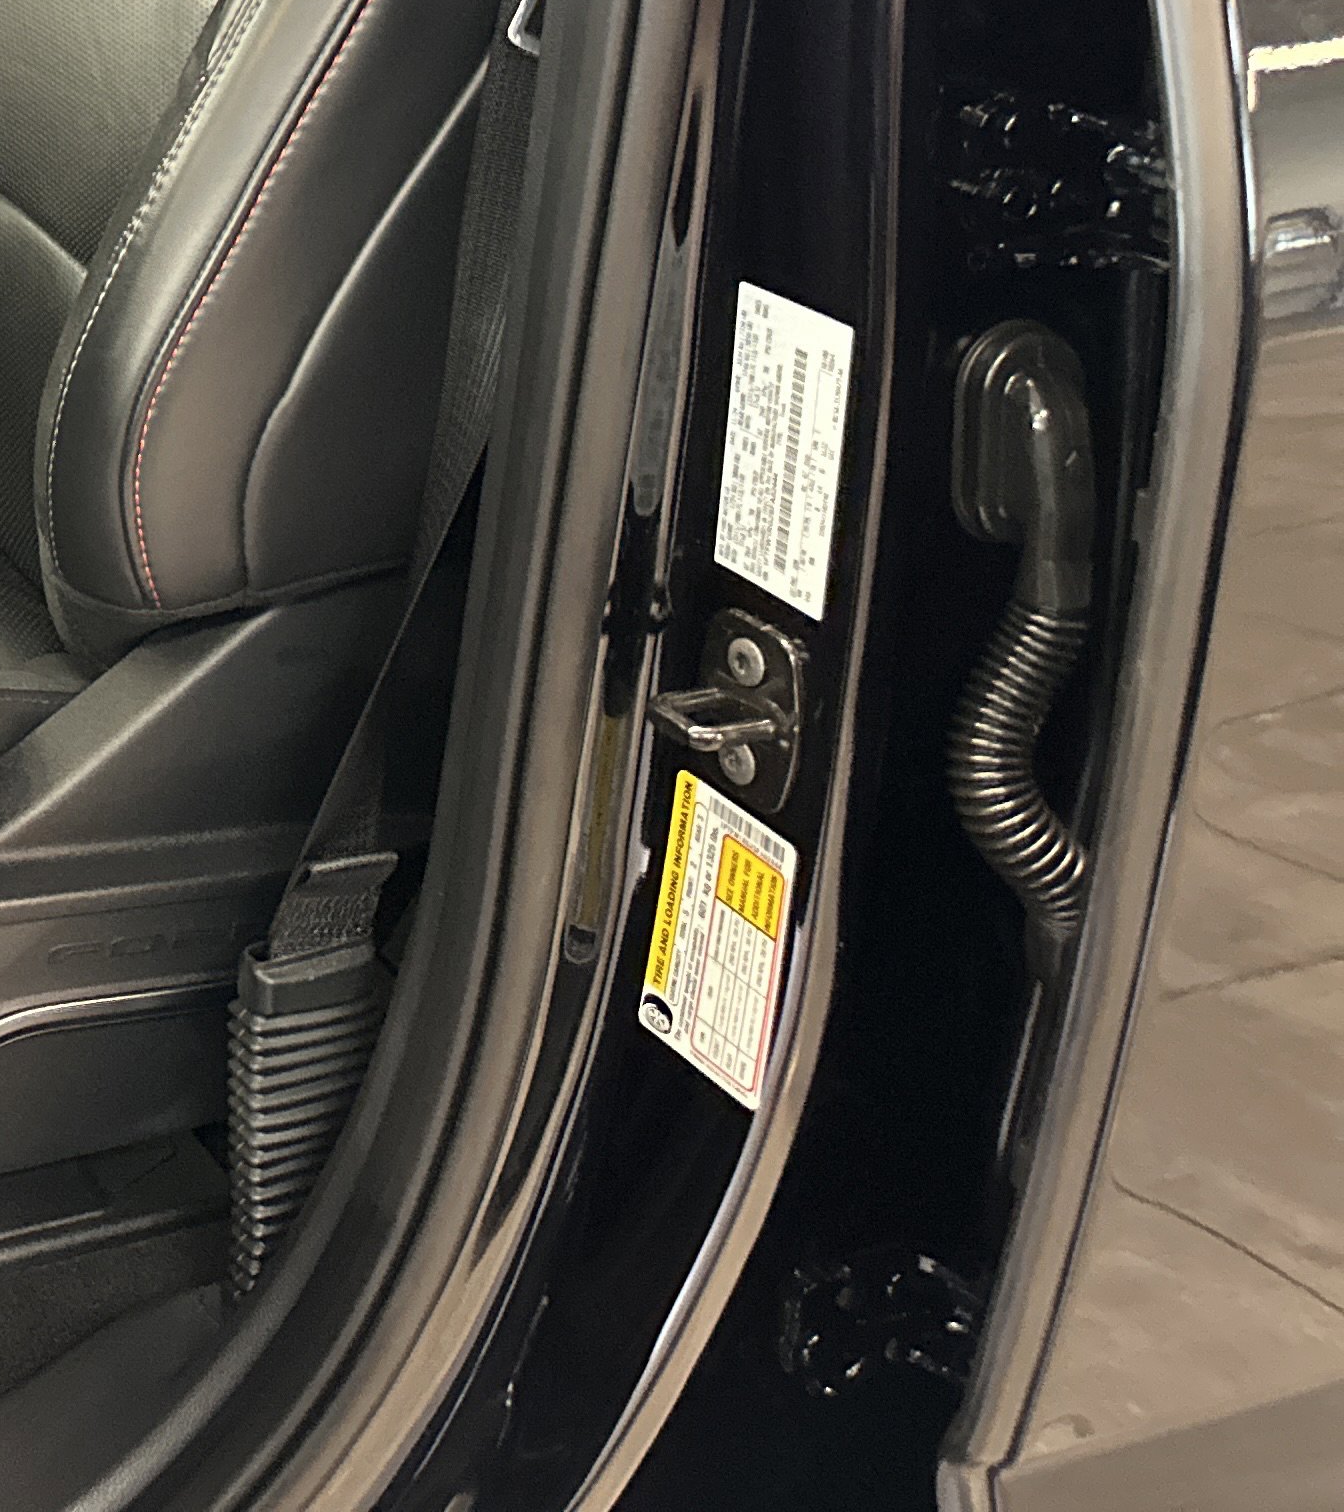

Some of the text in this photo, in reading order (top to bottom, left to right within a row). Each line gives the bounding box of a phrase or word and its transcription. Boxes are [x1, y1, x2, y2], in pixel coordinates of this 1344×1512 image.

[652, 778, 693, 987] TIRE AND LOADING INFORMATION
[737, 876, 749, 914] MANUAL
[750, 868, 764, 921] ADDITIONAL
[763, 873, 778, 933] INFORMATION
